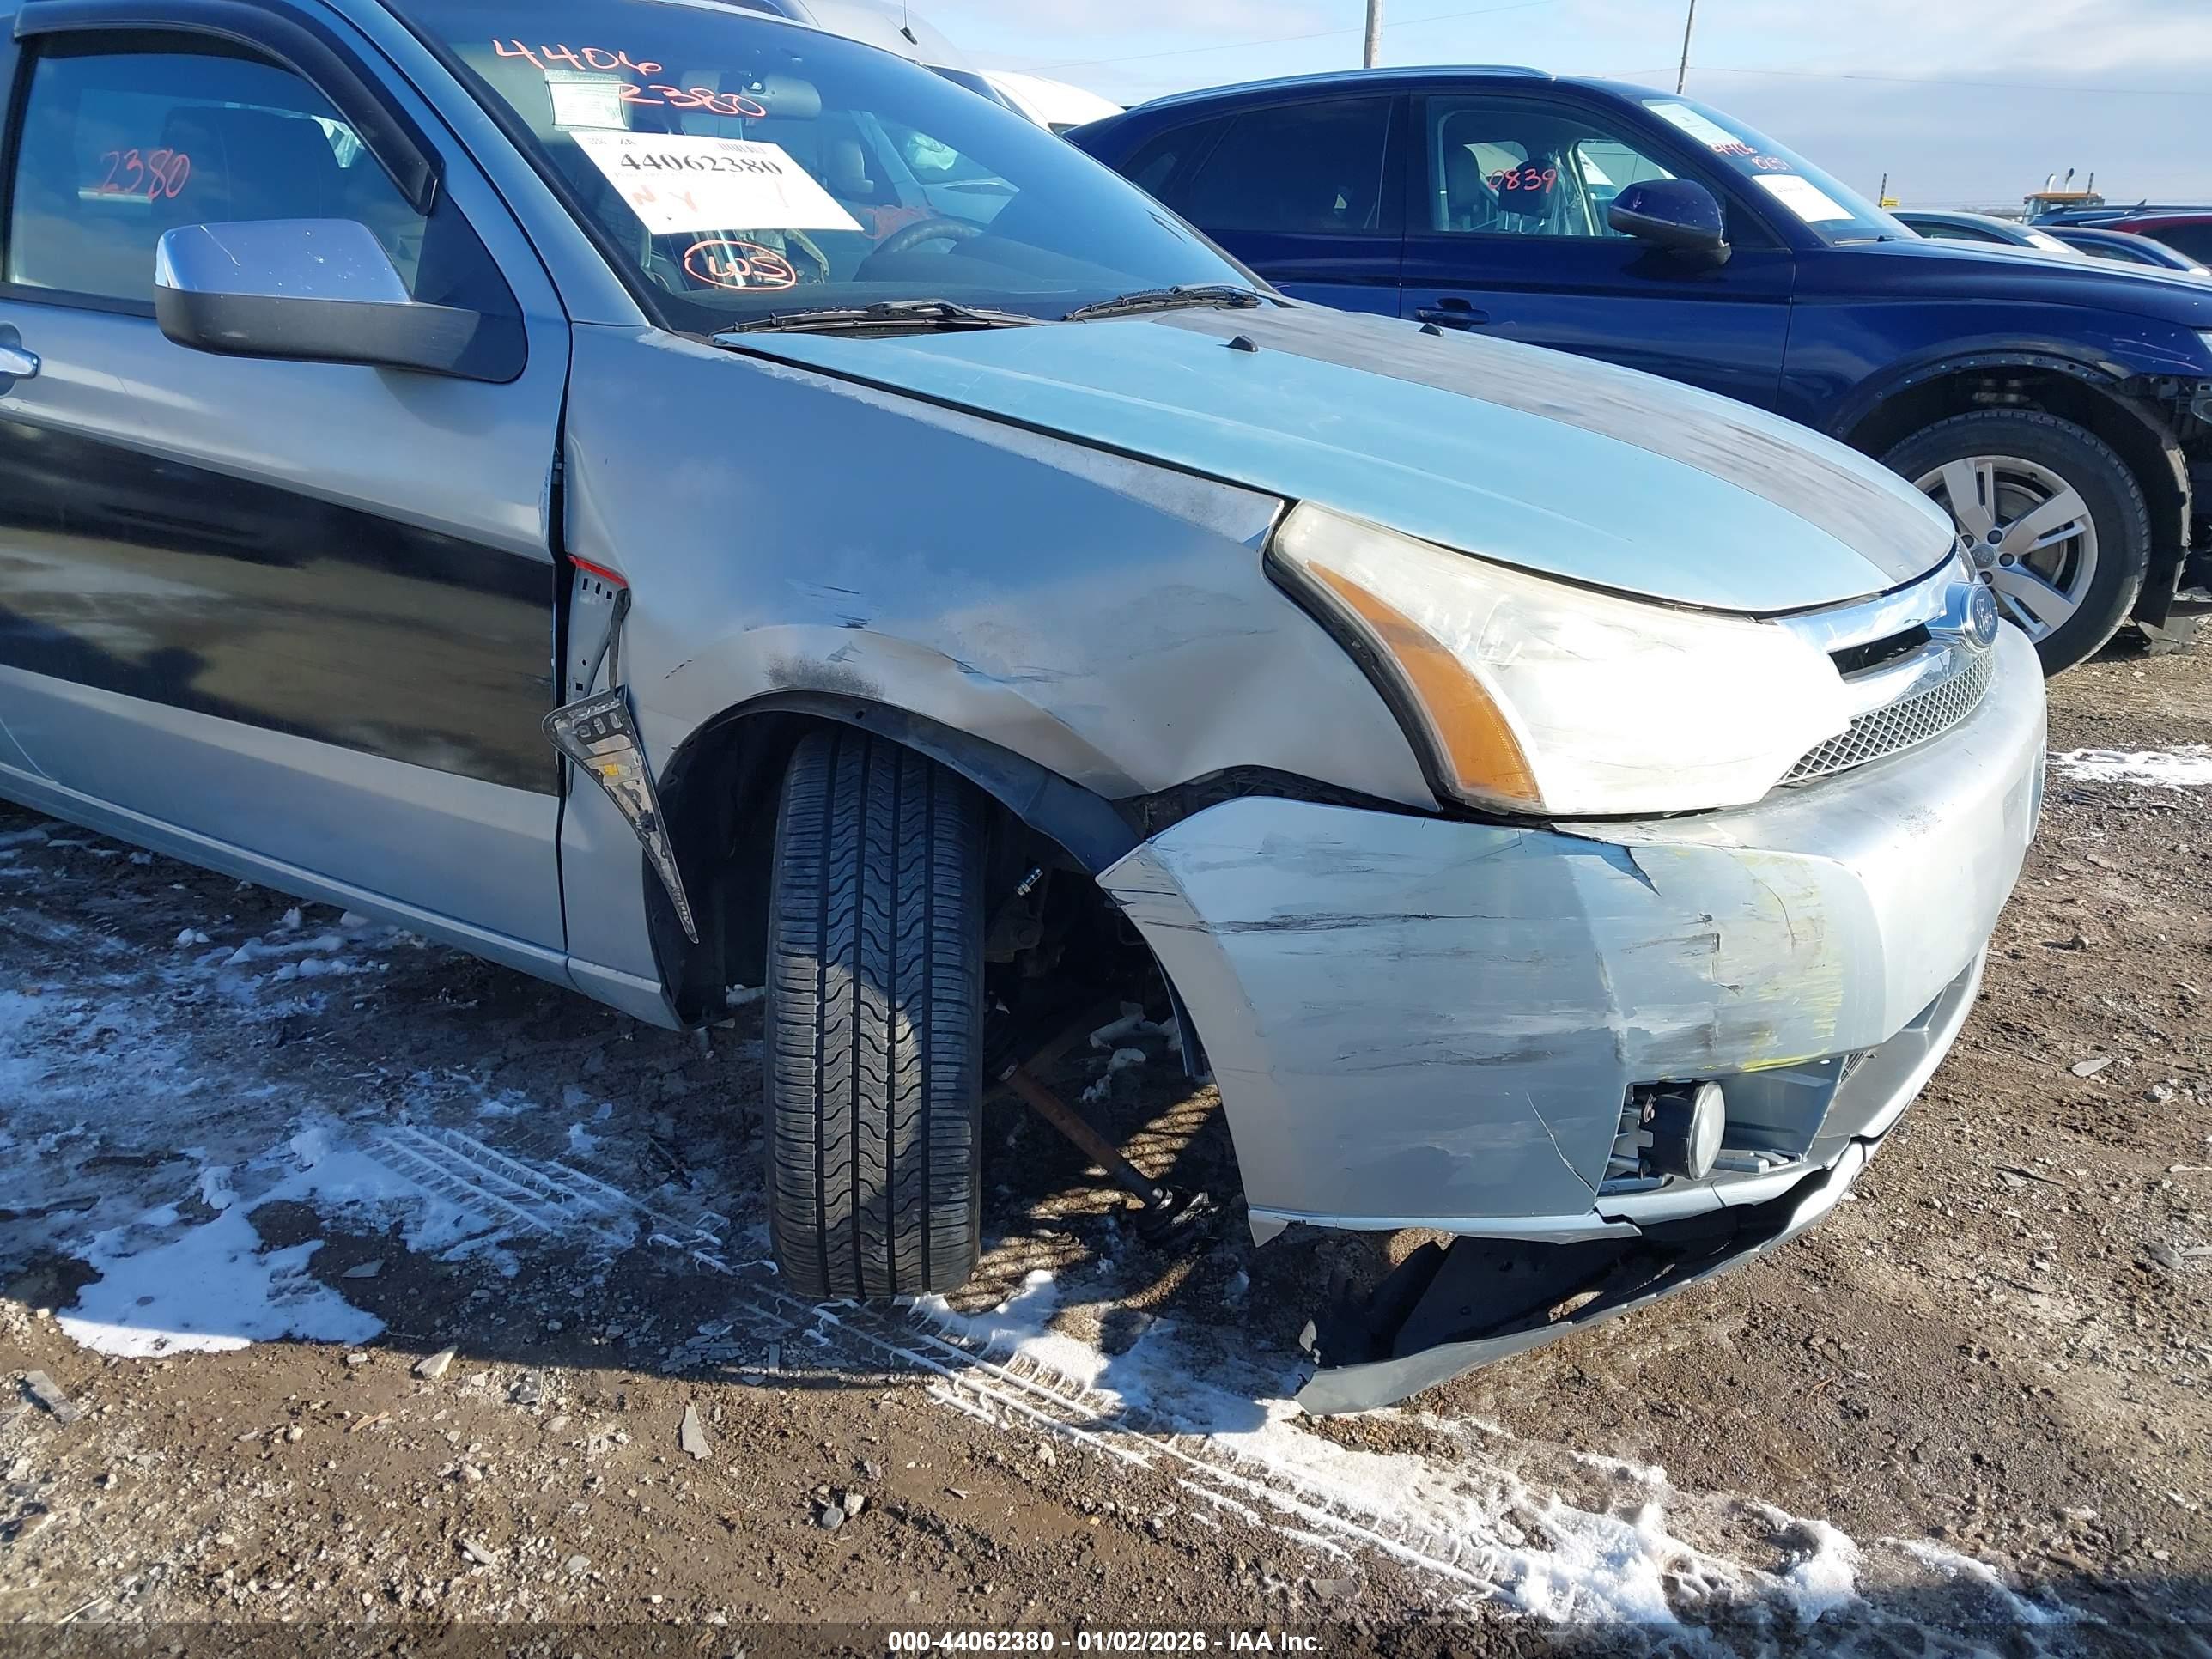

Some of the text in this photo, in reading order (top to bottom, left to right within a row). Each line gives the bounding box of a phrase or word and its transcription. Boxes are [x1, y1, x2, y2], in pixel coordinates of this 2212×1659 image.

[492, 40, 663, 76] 4406
[618, 83, 767, 118] 2380
[99, 148, 191, 200] 2380
[620, 152, 783, 175] 44062380
[1487, 168, 1557, 194] 0839
